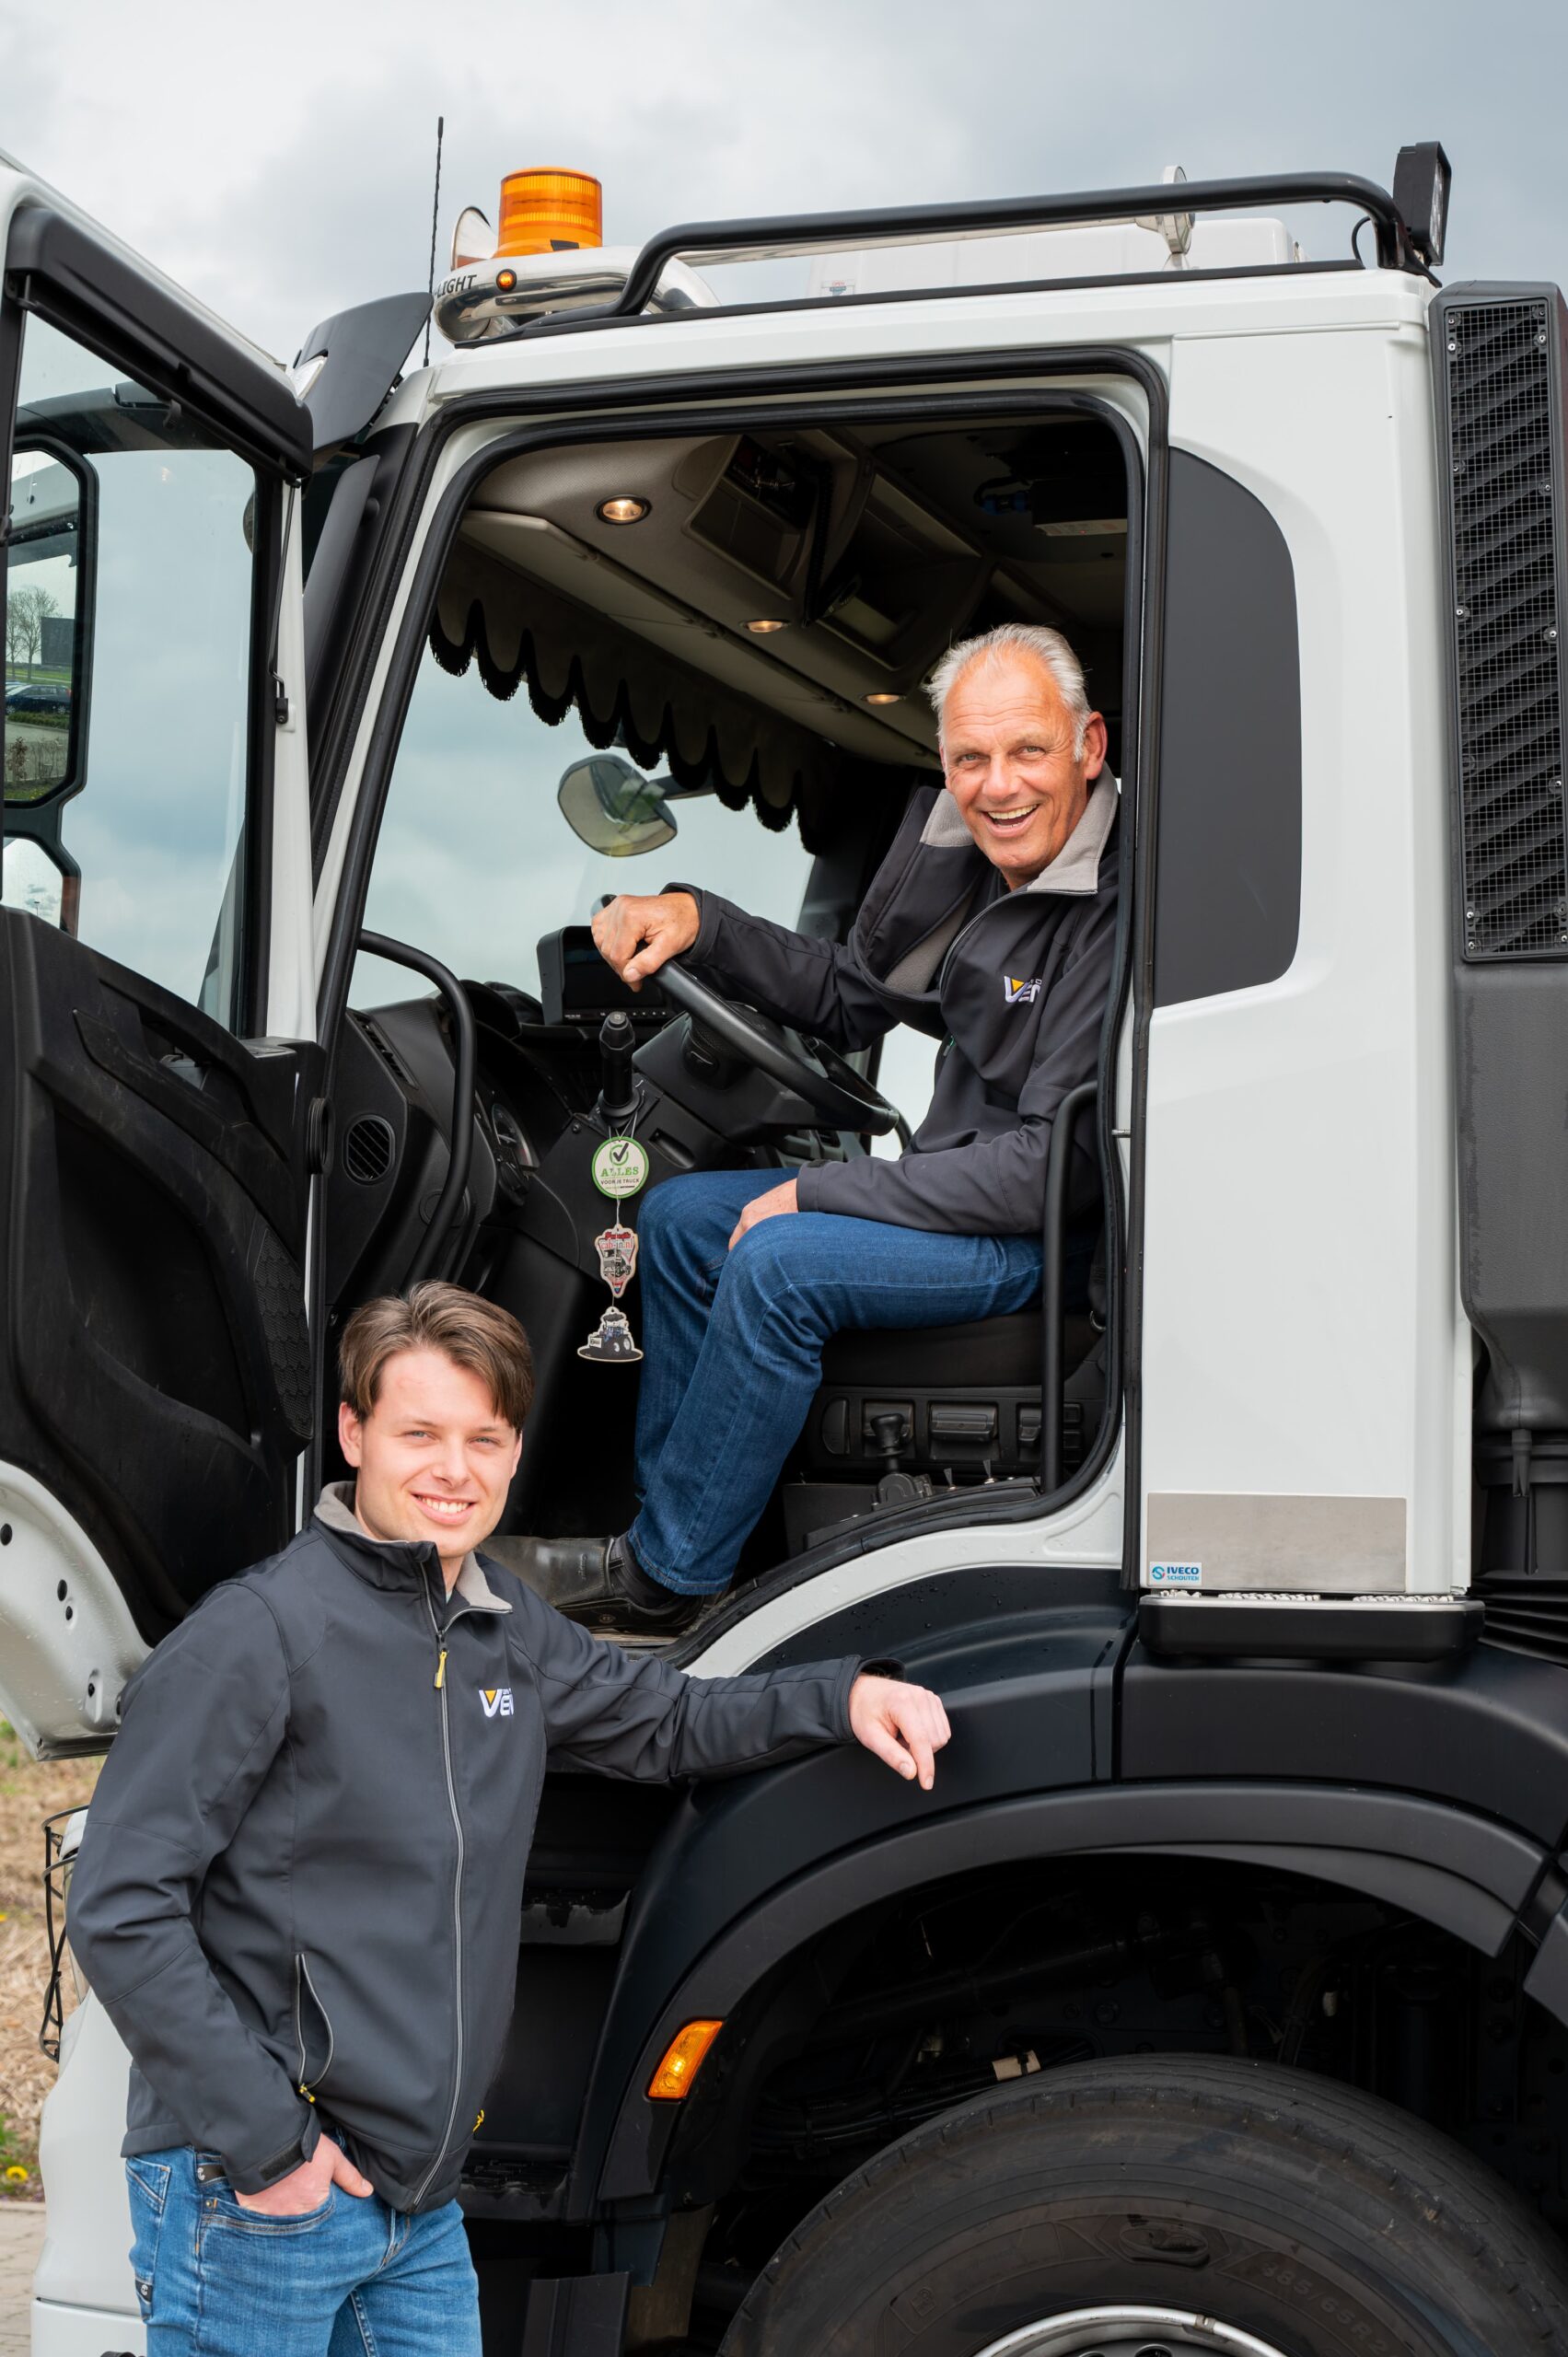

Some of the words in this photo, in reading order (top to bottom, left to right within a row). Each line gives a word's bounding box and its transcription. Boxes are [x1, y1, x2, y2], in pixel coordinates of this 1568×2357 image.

[434, 274, 477, 299] LIGHT
[600, 1166, 639, 1178] ALLES
[1167, 1566, 1200, 1575] IVECO
[1260, 2260, 1394, 2357] 385/65R2
